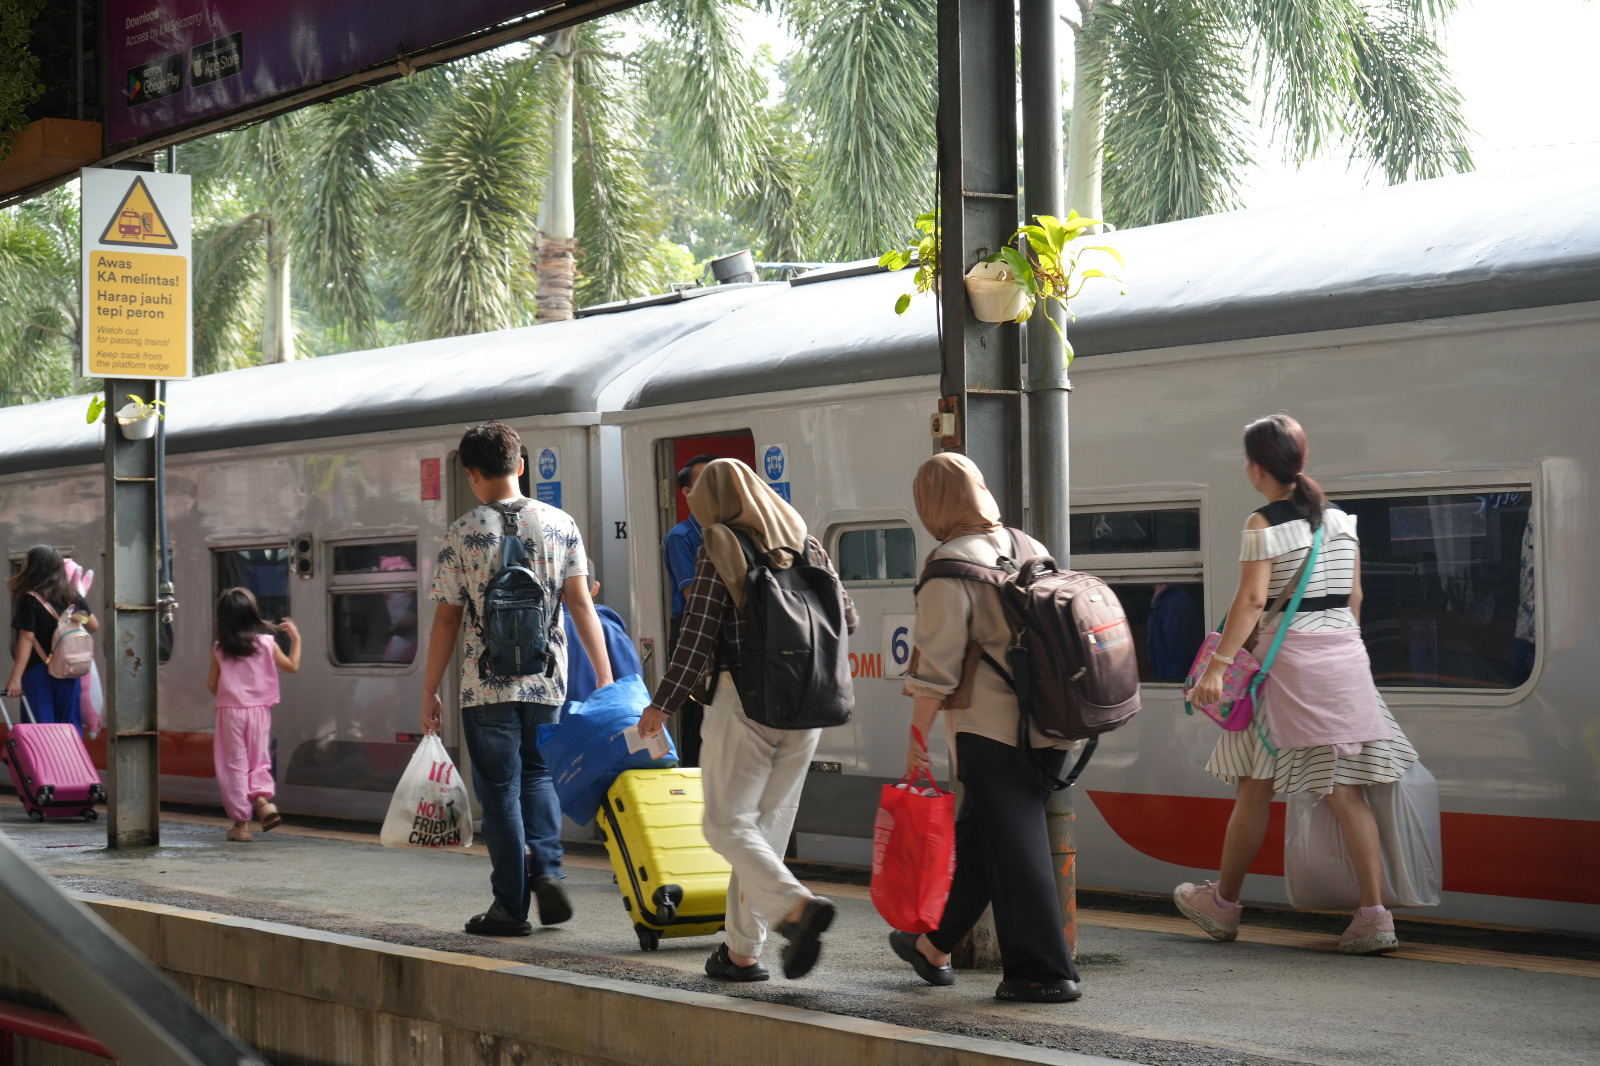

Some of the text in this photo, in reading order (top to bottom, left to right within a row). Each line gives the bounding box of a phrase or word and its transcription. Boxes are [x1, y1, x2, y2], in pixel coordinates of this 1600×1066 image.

[126, 8, 159, 29] Download
[126, 29, 149, 47] Access
[150, 27, 158, 40] by
[204, 53, 239, 76] App Store
[143, 72, 180, 94] Google Play
[97, 256, 132, 269] Awas
[97, 271, 179, 287] KA melintas!
[97, 290, 173, 306] Harap jauhi
[97, 306, 164, 320] tepi peron
[97, 326, 139, 336] Watch out
[97, 335, 170, 347] for passing trains!
[97, 350, 162, 361] Keep back from
[97, 360, 170, 372] the platform edge
[615, 521, 627, 539] K
[892, 626, 909, 665] 6
[416, 800, 444, 820] NO.1
[412, 816, 447, 834] FRIED
[408, 829, 461, 847] CHICKEN
